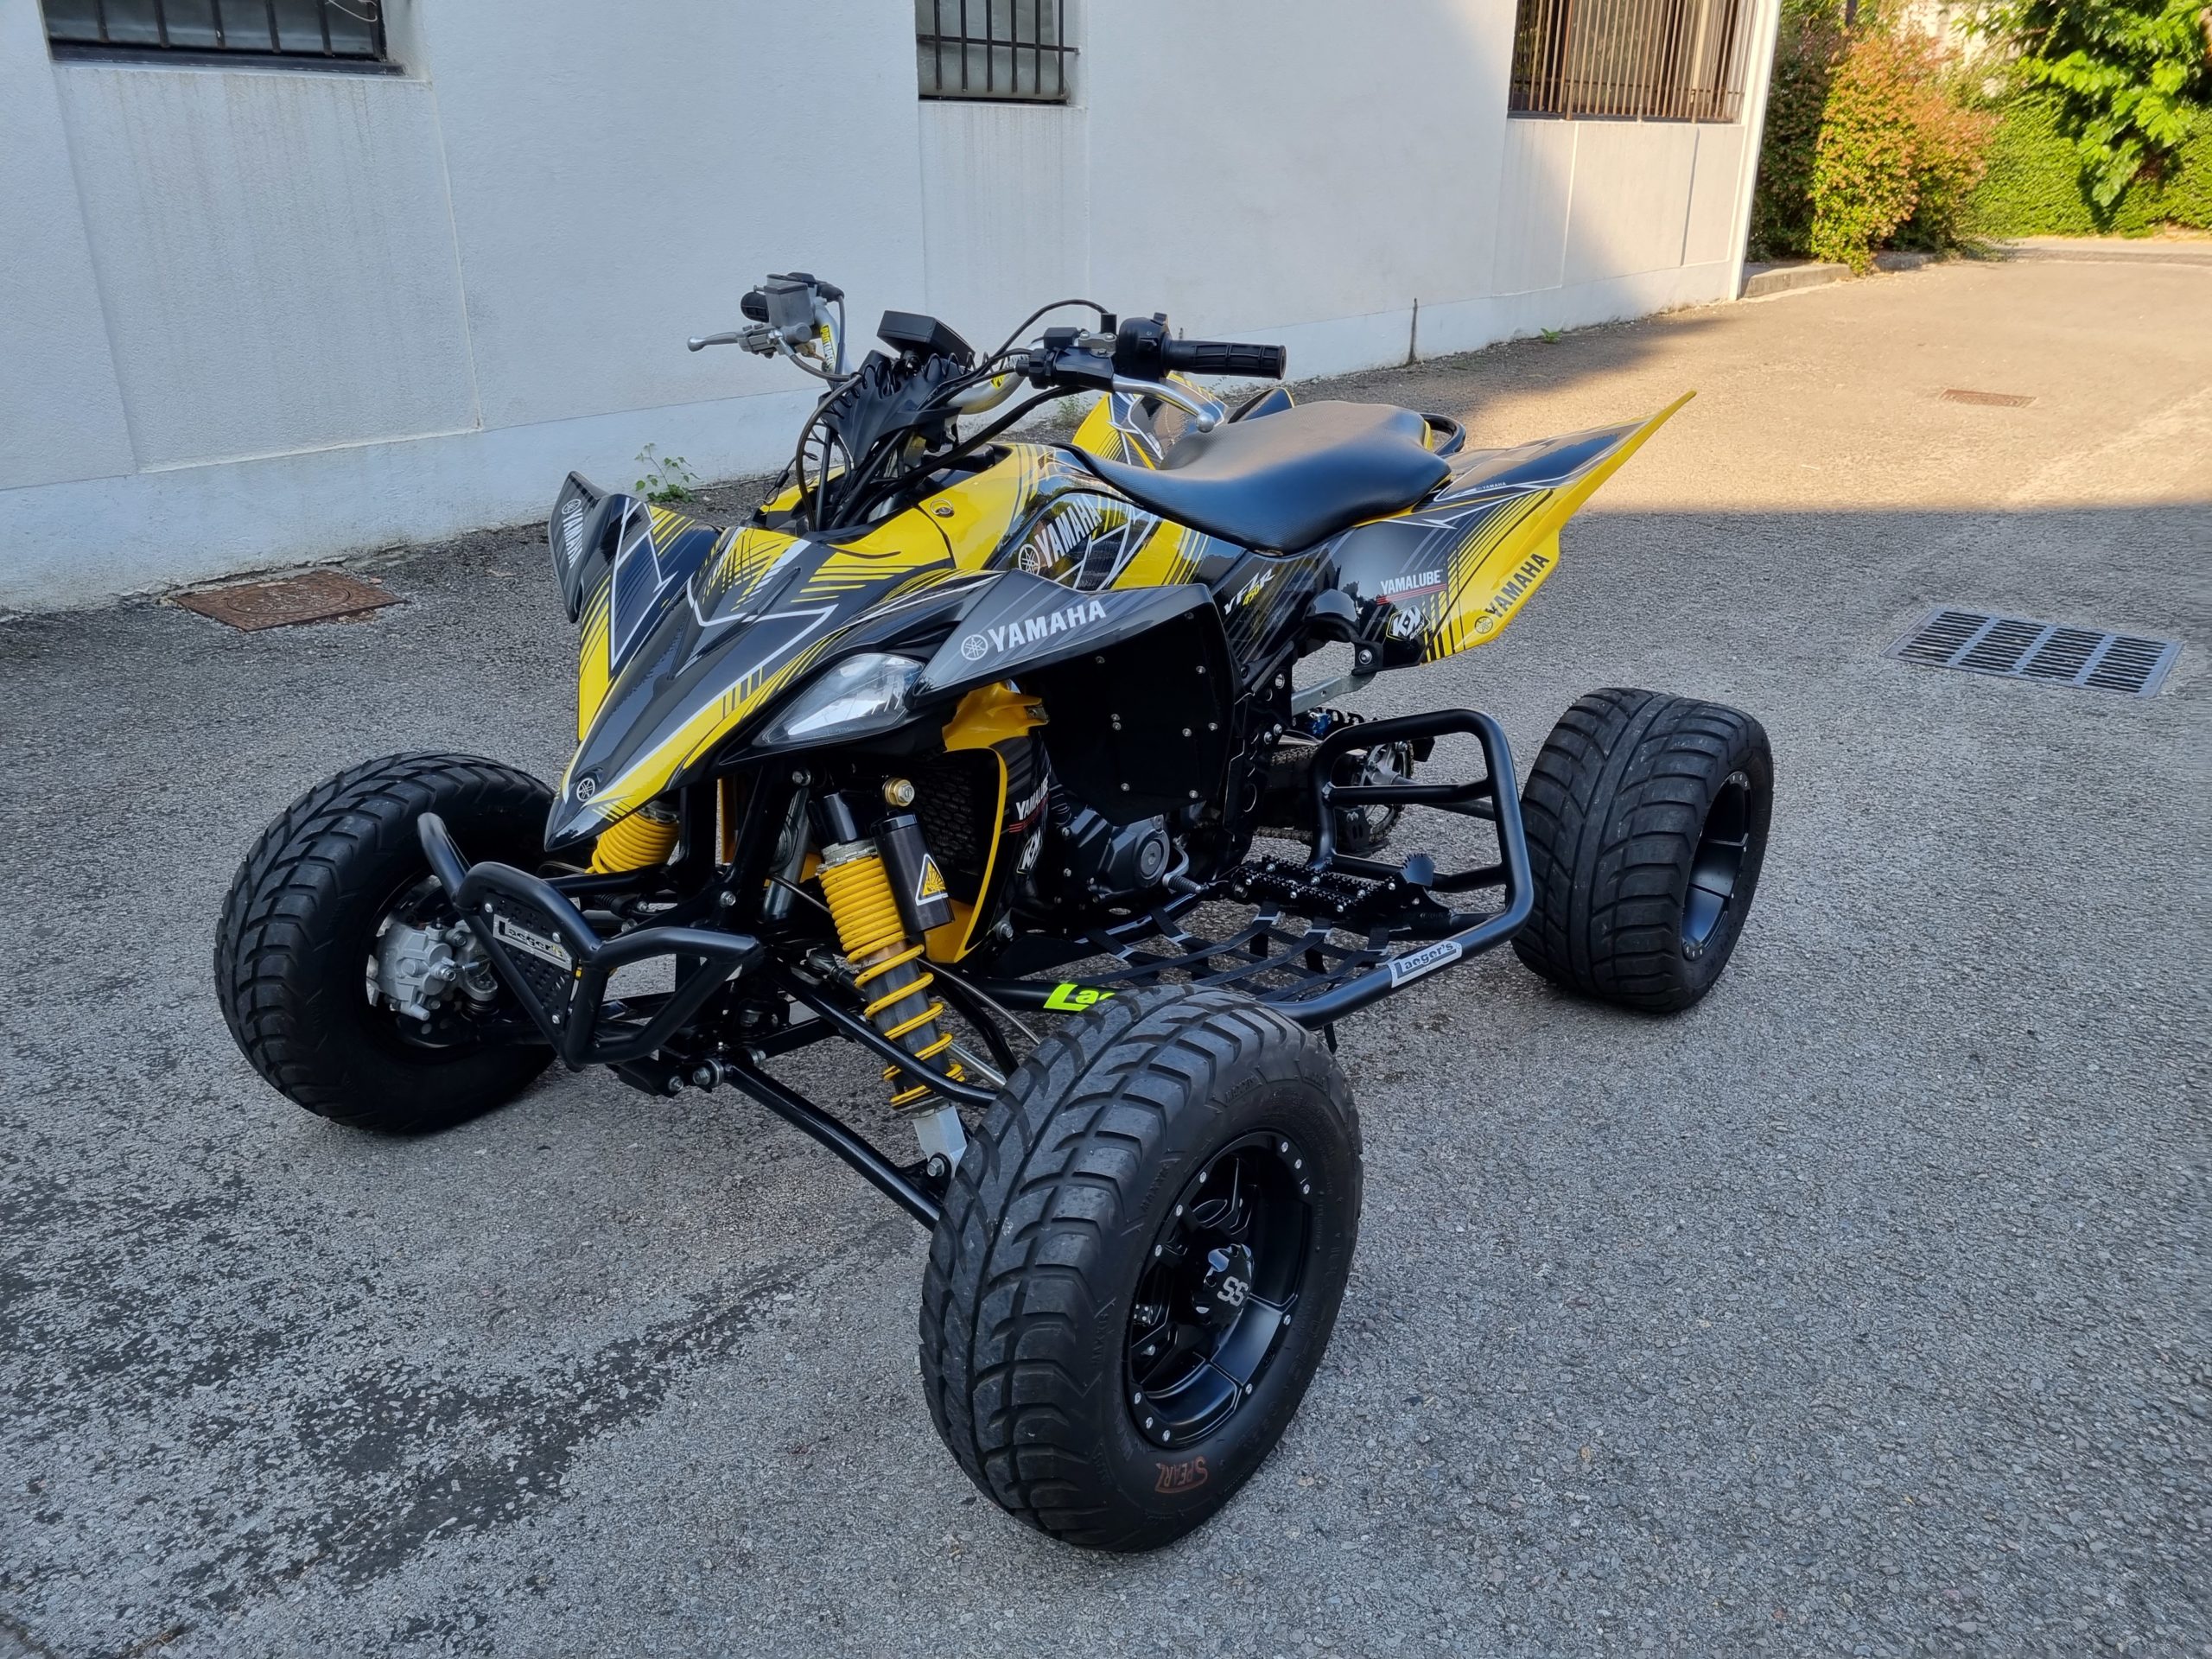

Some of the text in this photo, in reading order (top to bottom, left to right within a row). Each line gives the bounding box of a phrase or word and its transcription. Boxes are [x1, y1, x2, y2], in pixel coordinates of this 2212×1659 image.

[563, 507, 583, 569] YAMAHA
[1034, 493, 1103, 568] YAMAHA
[1381, 571, 1441, 595] YAMALUBE
[1485, 552, 1550, 619] YAMAHA
[988, 600, 1107, 653] YAMAHA
[1394, 943, 1457, 979] Laeger's
[1217, 1275, 1249, 1306] SS
